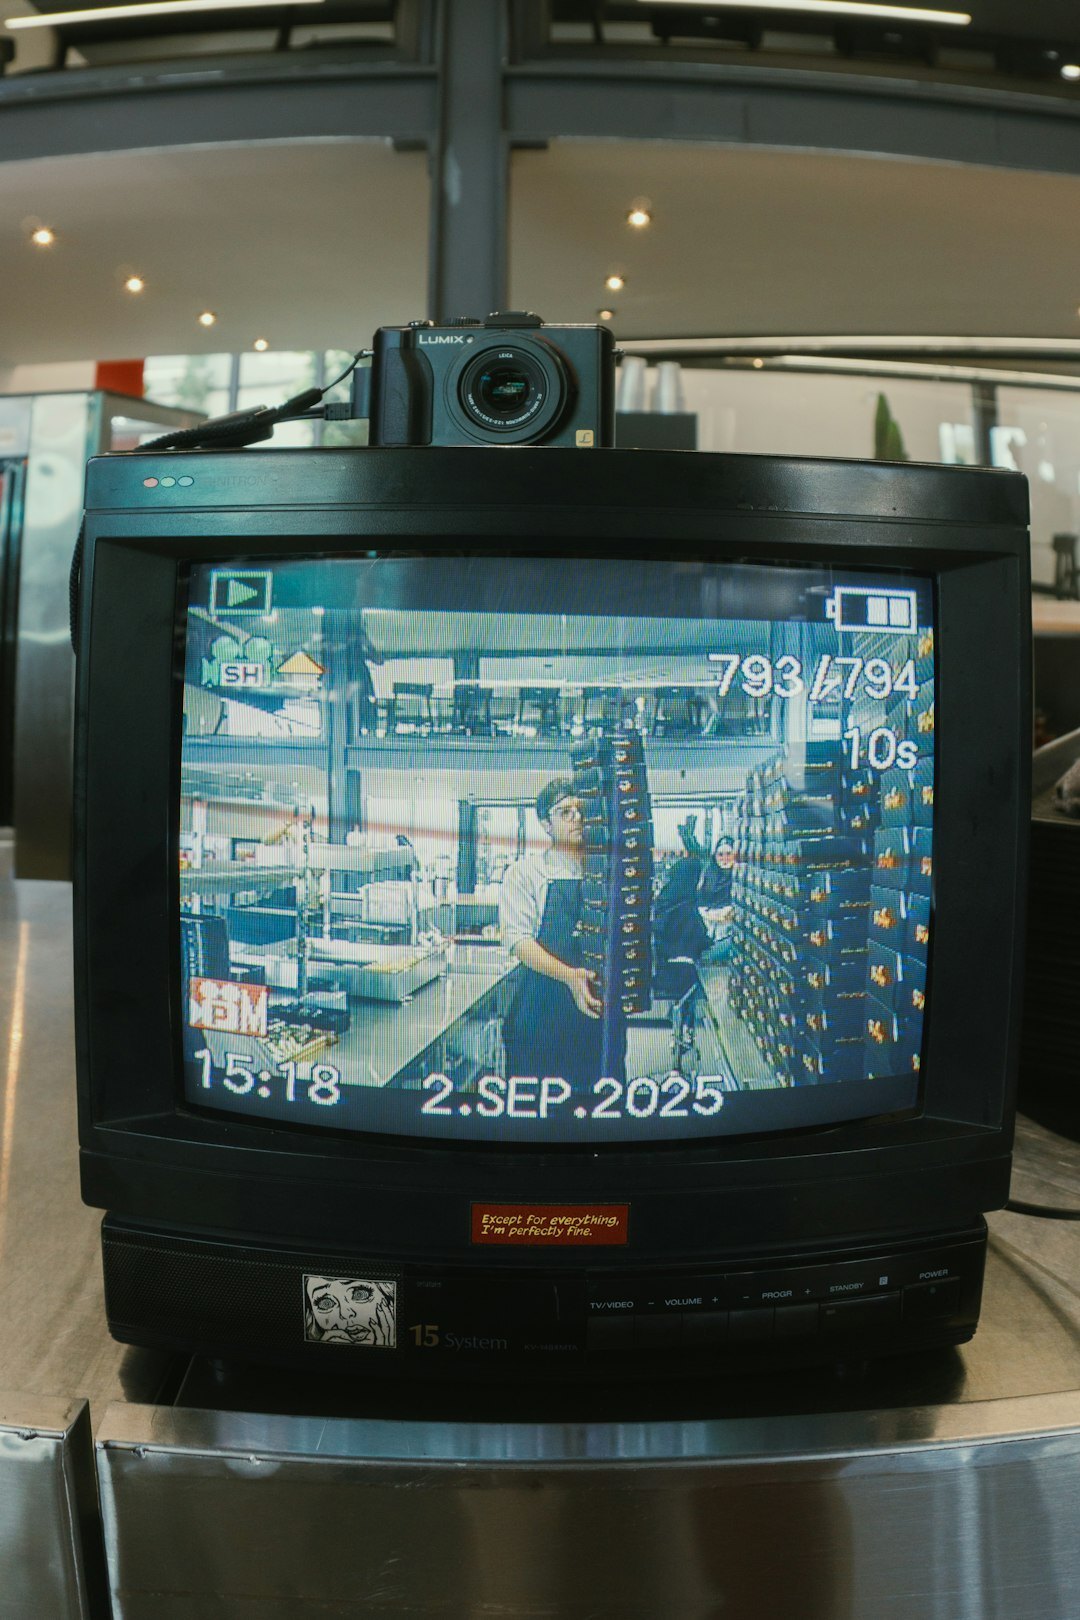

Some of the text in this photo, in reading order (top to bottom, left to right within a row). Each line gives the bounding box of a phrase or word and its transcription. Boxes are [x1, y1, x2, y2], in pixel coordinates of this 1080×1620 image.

[418, 334, 464, 345] LUMIX
[224, 665, 259, 684] SH
[843, 726, 919, 770] 10s
[194, 1048, 342, 1107] 15:18
[421, 1072, 725, 1118] 2.SEP.2025
[481, 1213, 620, 1228] Except for everything,
[481, 1224, 593, 1238] I'm perfectly fine.
[919, 1268, 949, 1279] POWER
[829, 1281, 864, 1293] STANDBY
[664, 1297, 703, 1306] VOLUME
[761, 1289, 793, 1300] PROGR
[589, 1301, 634, 1310] TV/VIDEO
[409, 1324, 508, 1353] 15 System
